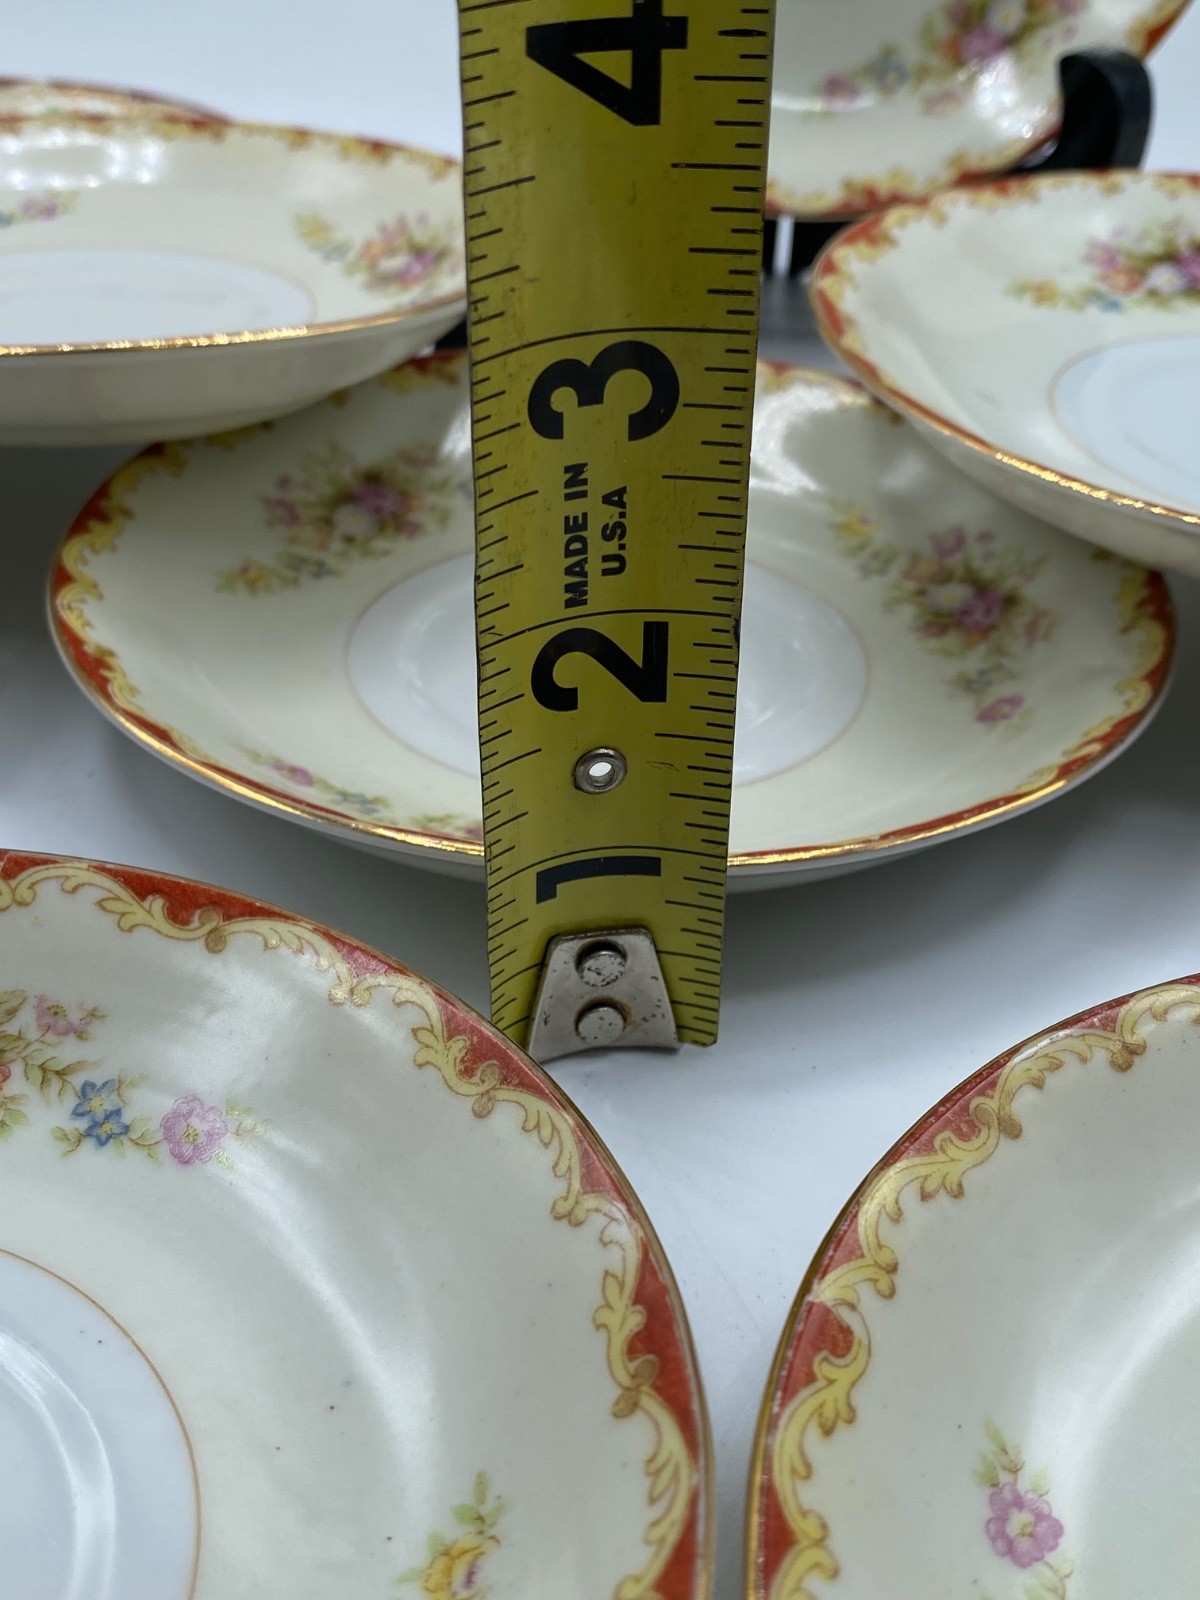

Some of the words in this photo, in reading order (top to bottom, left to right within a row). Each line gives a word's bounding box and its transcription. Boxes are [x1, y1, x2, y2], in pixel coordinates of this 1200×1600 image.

[526, 0, 688, 125] 4
[527, 340, 680, 441] 3
[564, 462, 588, 501] IN
[564, 511, 588, 609] MADE
[601, 485, 628, 577] U.S.A
[531, 621, 669, 711] 2
[536, 856, 662, 904] 1
